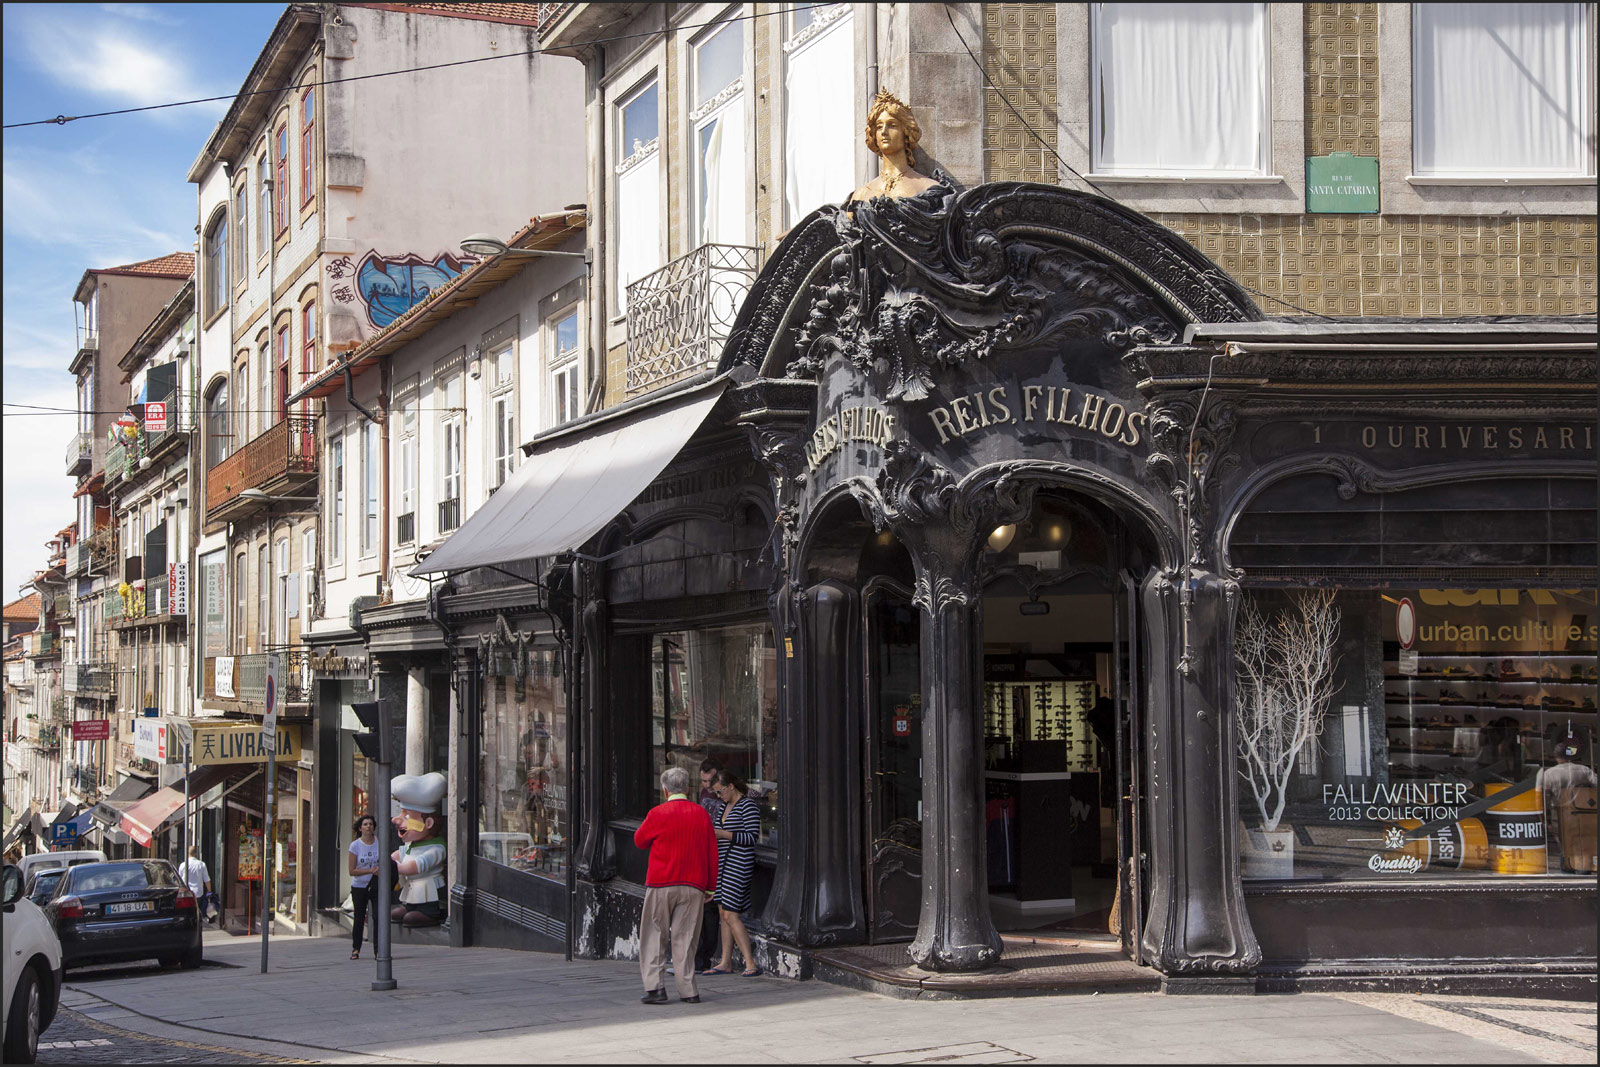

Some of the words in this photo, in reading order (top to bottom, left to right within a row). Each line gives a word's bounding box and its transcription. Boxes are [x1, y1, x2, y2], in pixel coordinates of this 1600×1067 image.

[1309, 185, 1334, 195] SANTA
[1337, 185, 1376, 195] CATARINA
[928, 386, 1017, 444] REIS,
[1022, 385, 1148, 446] FILHOS
[841, 407, 895, 449] FILHOS
[1362, 426, 1592, 449] OURIVESARI
[169, 563, 177, 598] VENDE
[169, 600, 176, 615] SE
[220, 732, 293, 759] LIVRAIA
[1322, 783, 1468, 805] FALL/WINTER
[1328, 806, 1362, 821] 2013
[1366, 806, 1459, 820] COLLECTION
[56, 824, 67, 837] P
[1368, 853, 1423, 874] Quality
